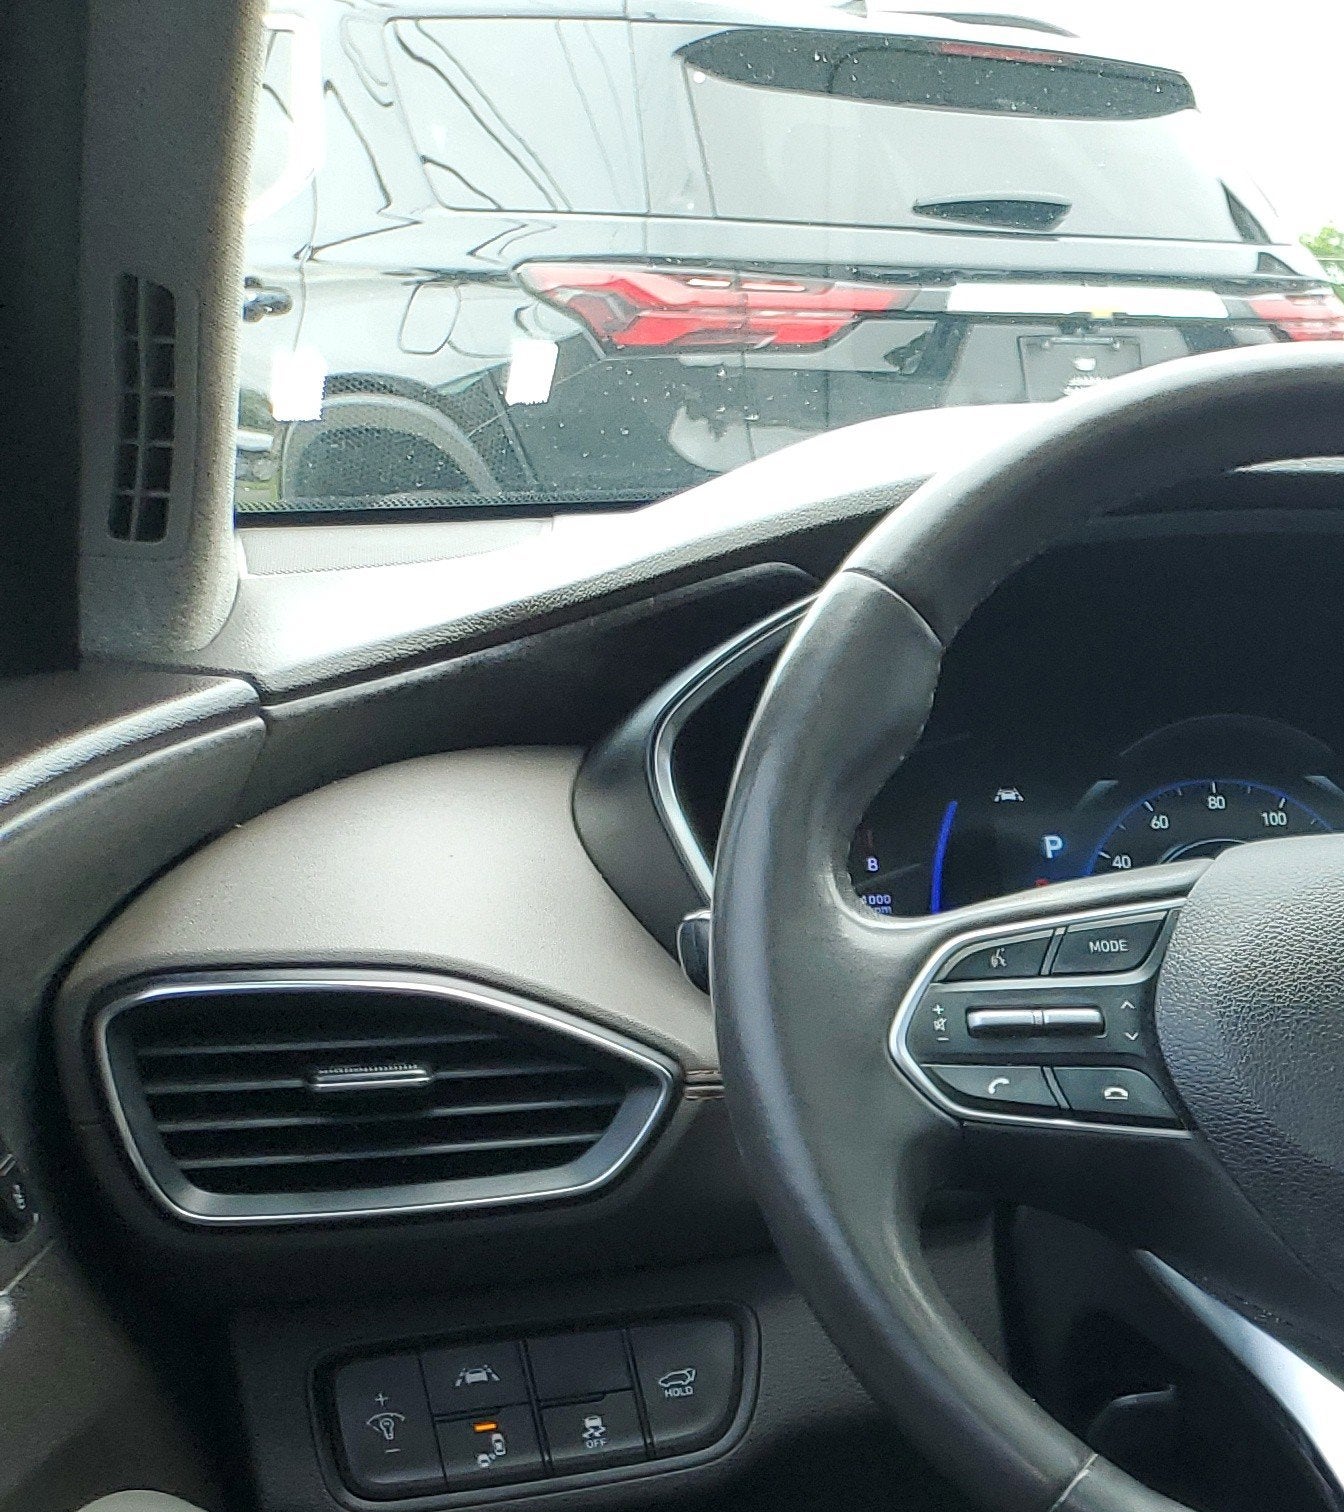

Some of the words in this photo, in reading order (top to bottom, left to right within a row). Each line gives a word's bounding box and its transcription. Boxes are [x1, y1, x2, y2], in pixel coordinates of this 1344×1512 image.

[1207, 796, 1226, 810] 80
[1150, 815, 1169, 830] 60
[1261, 811, 1287, 826] 100
[1044, 835, 1063, 859] P
[1112, 855, 1132, 869] 40
[1089, 939, 1128, 954] MODE
[664, 1386, 694, 1398] HOLD
[586, 1438, 606, 1449] OFF
